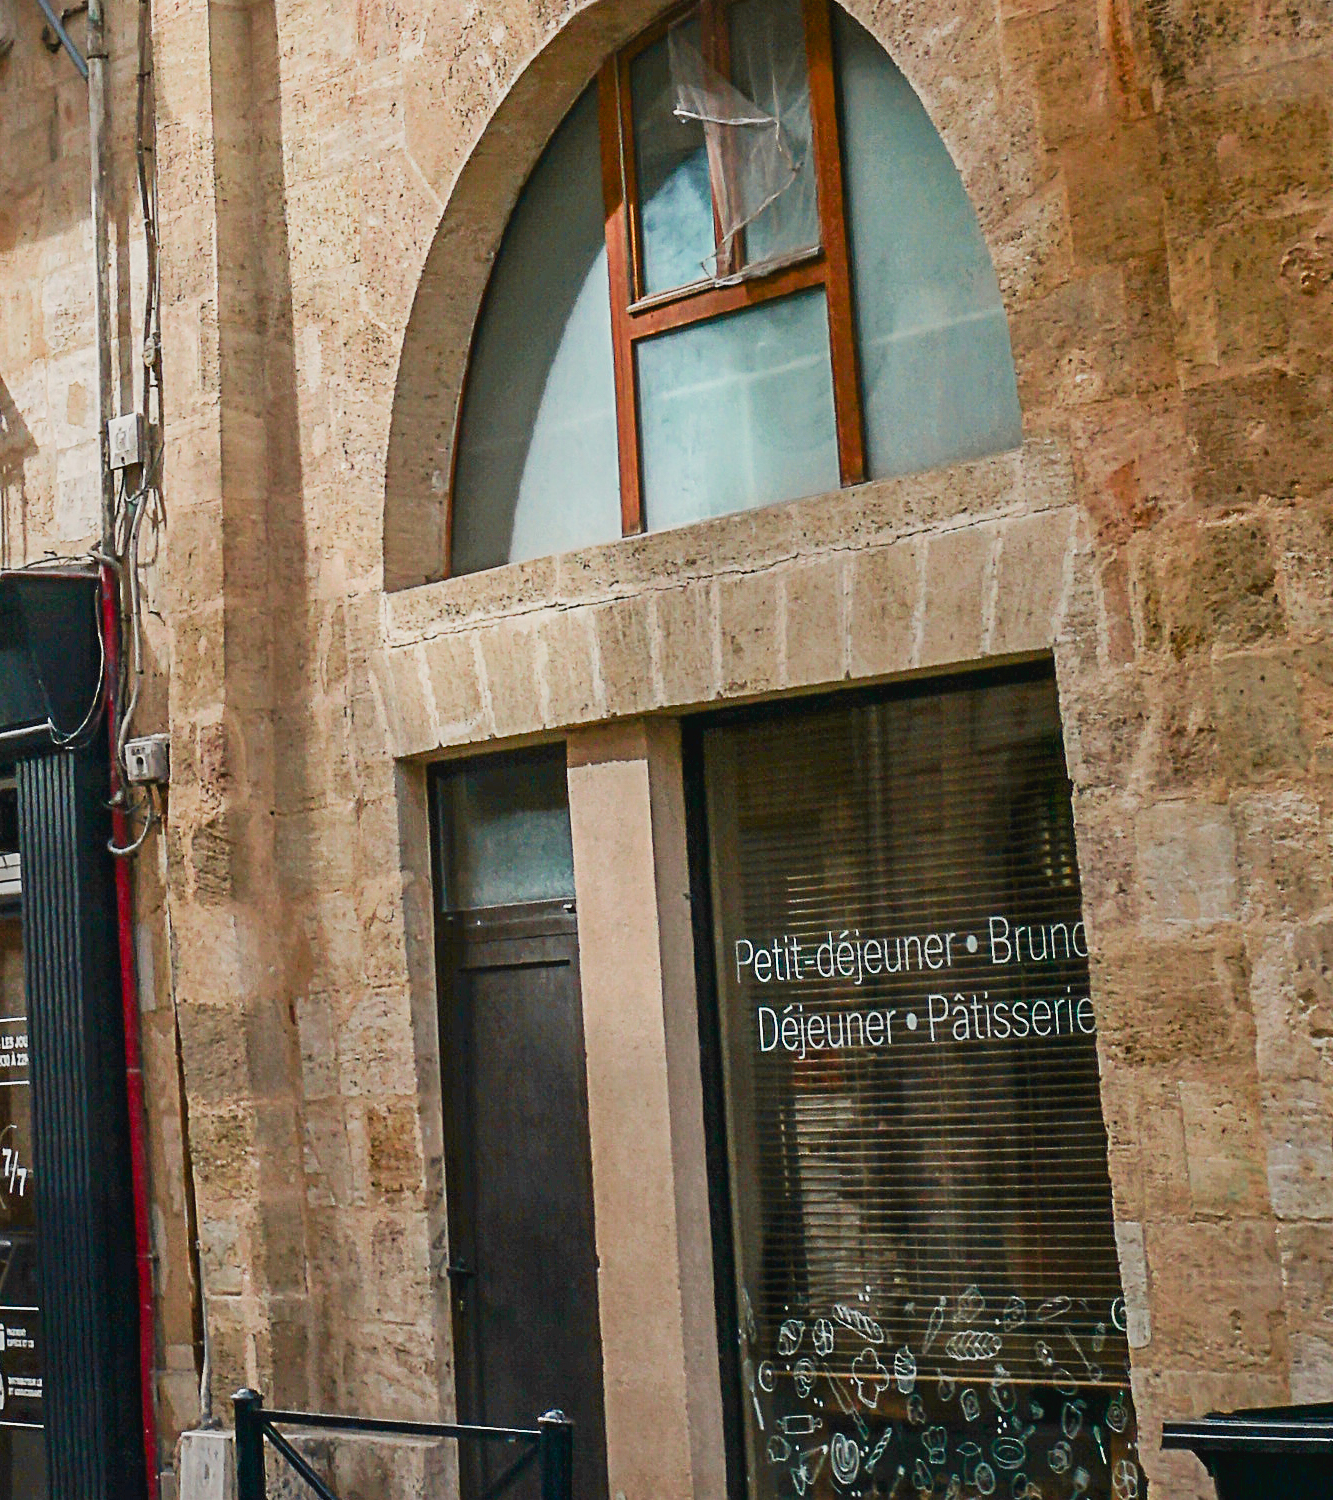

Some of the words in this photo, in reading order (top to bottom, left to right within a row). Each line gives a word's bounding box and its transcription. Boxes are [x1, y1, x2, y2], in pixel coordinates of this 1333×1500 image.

[735, 929, 957, 986] Petit-déjeuner
[2, 1036, 14, 1049] LES
[758, 1002, 897, 1060] Déjeuner
[2, 1148, 28, 1197] 7/7
